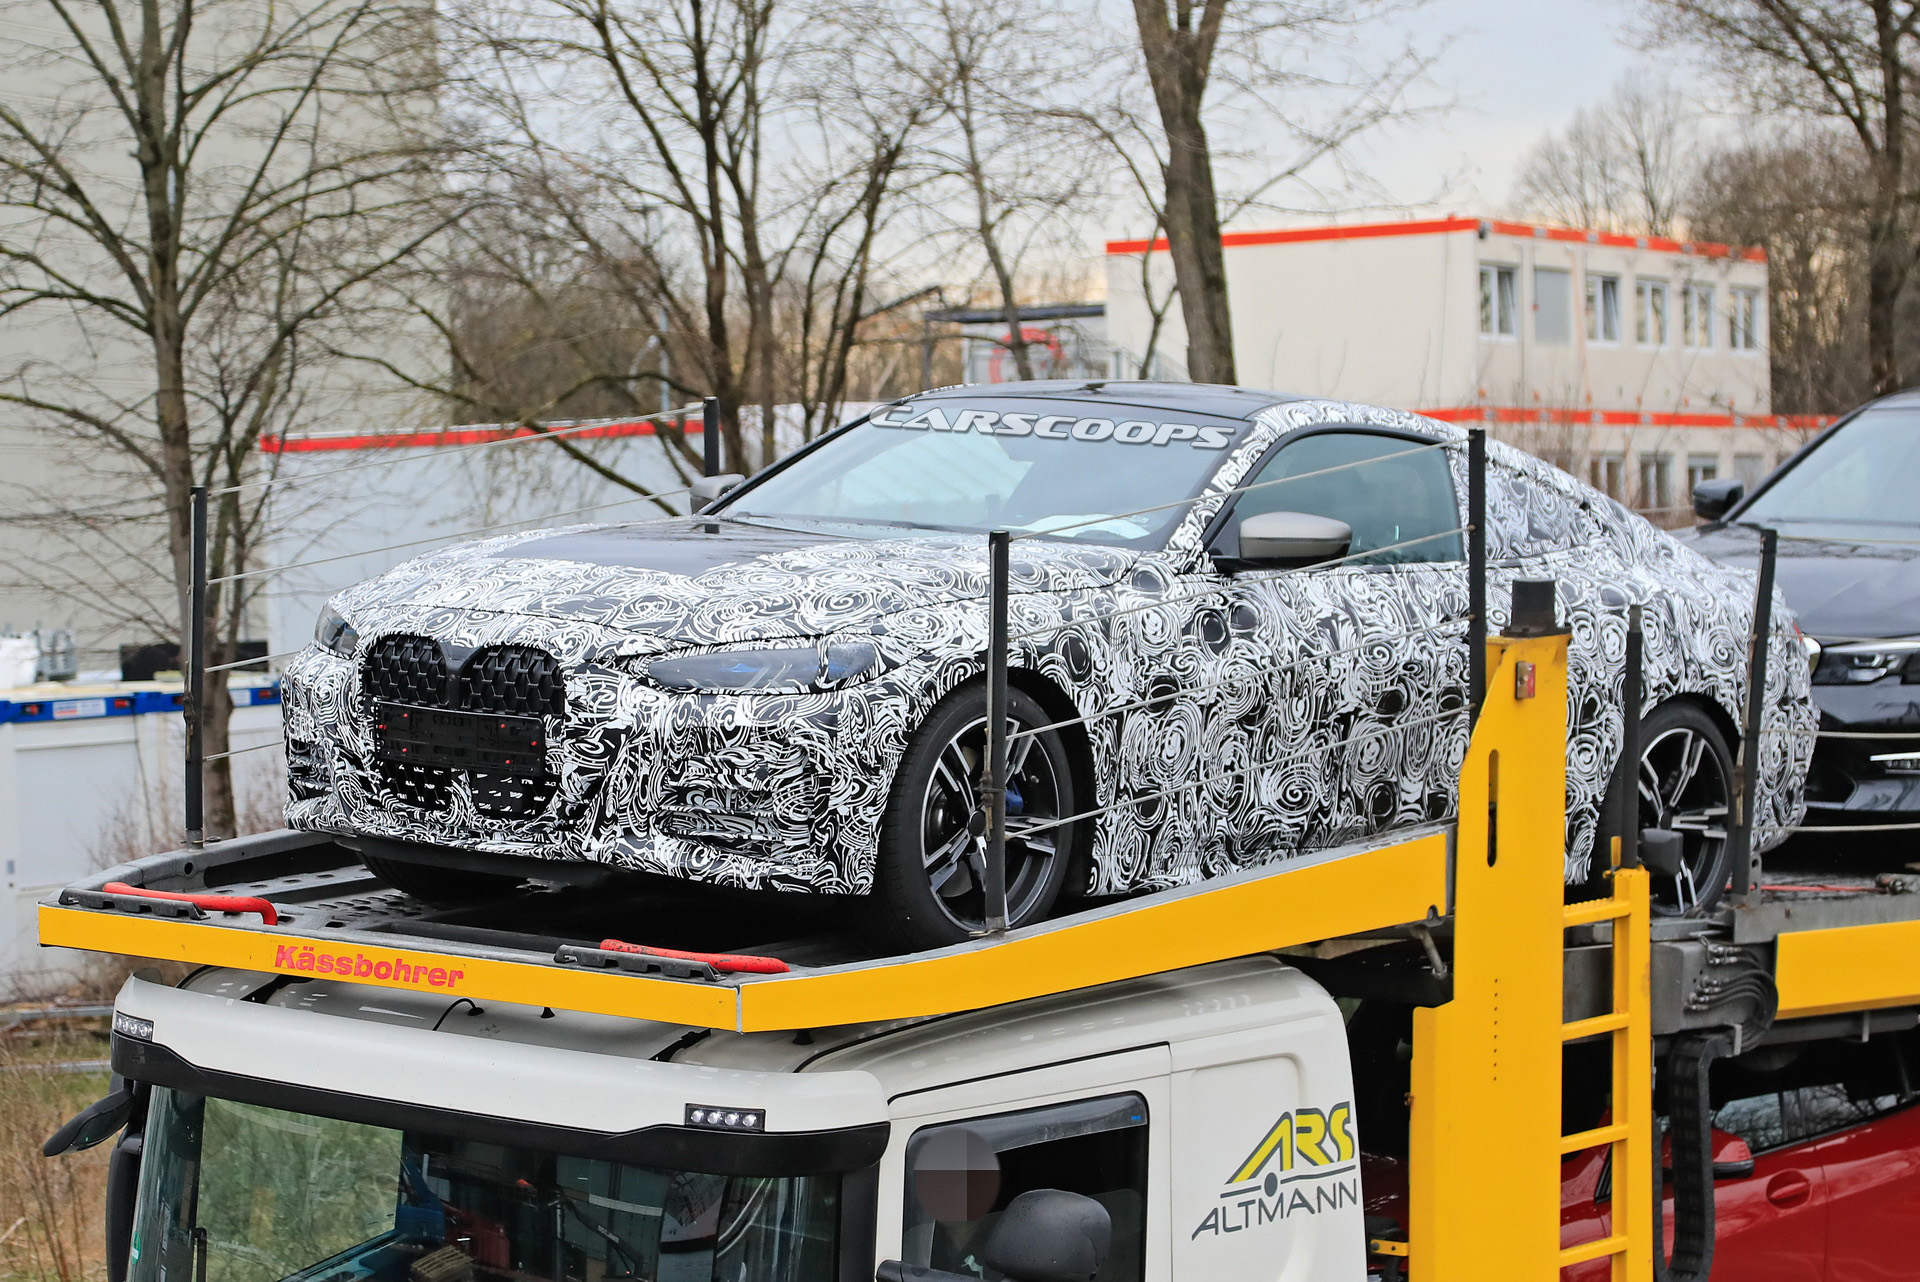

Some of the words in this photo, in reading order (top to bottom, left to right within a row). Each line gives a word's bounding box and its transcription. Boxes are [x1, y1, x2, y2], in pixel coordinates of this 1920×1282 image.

[275, 944, 464, 988] Kässbohrer
[1224, 1101, 1355, 1185] ARS
[1191, 1178, 1357, 1241] ALTMANN
